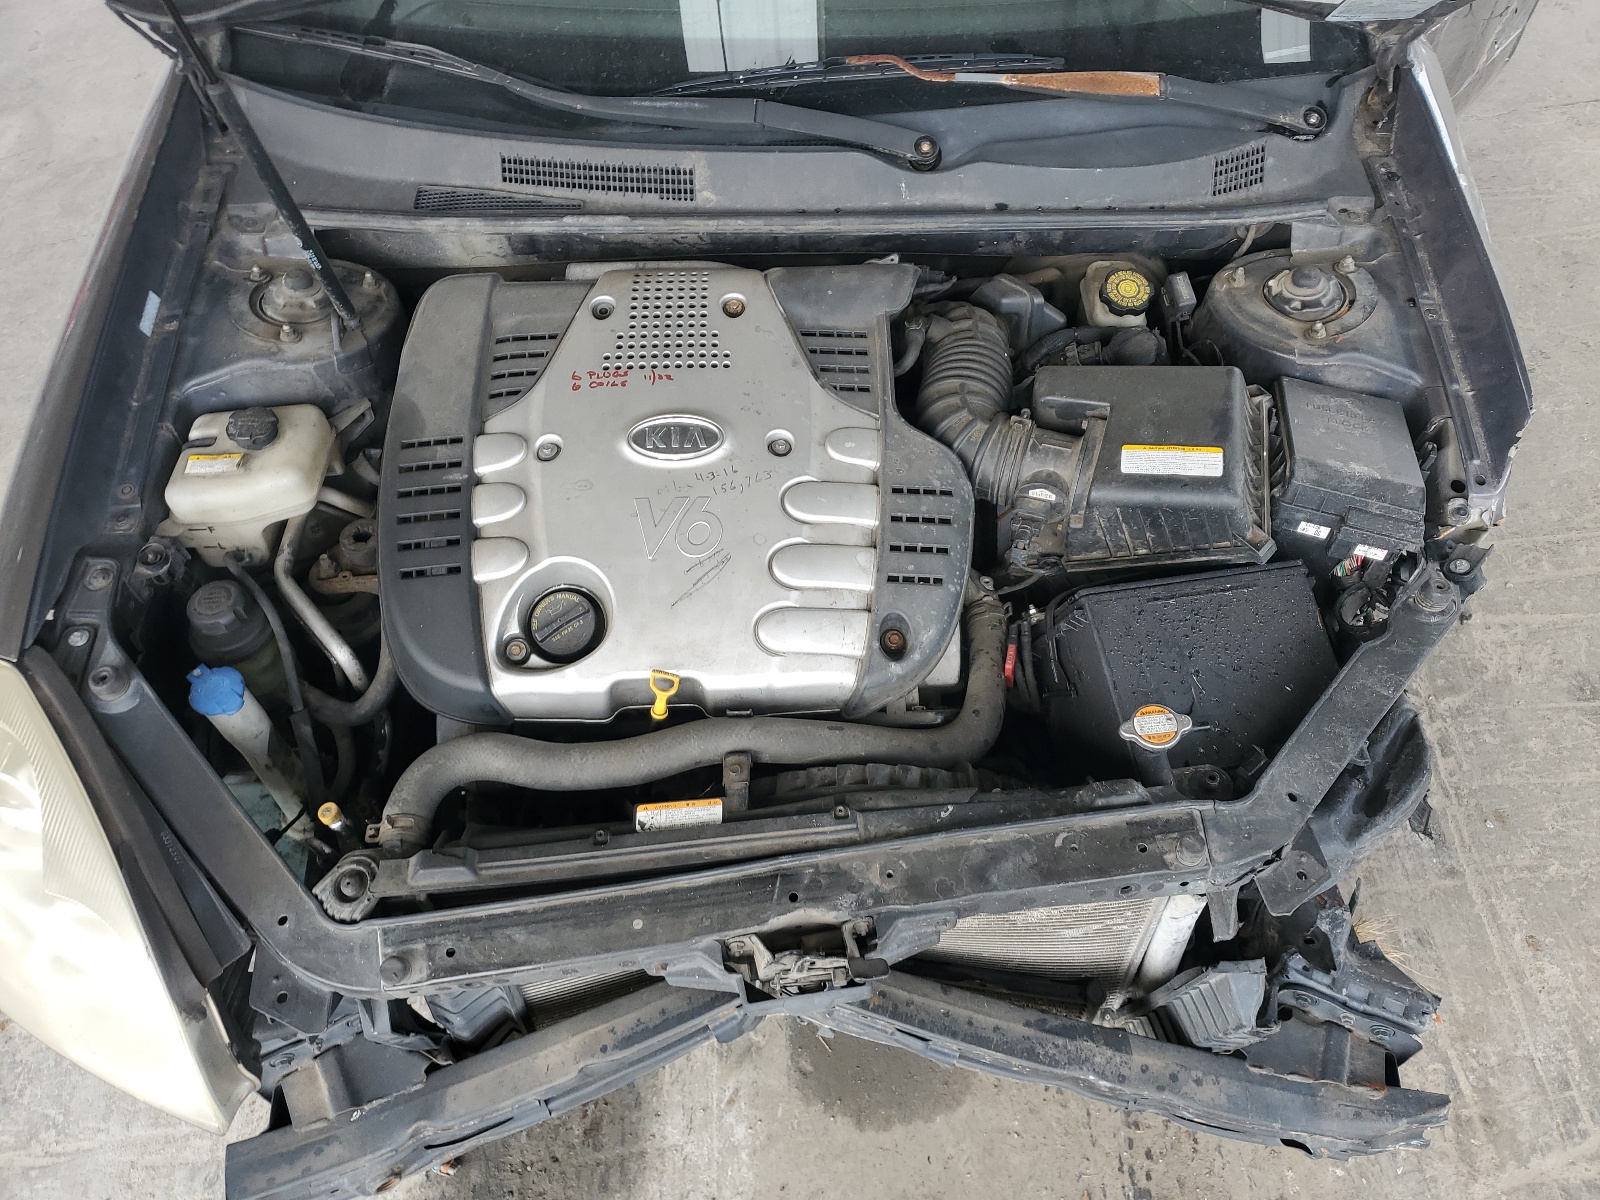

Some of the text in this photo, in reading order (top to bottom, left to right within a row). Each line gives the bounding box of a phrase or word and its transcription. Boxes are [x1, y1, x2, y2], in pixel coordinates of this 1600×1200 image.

[587, 370, 629, 380] PLUGS
[645, 426, 708, 449] KIA
[633, 495, 724, 560] V6
[556, 593, 580, 604] MANUAL
